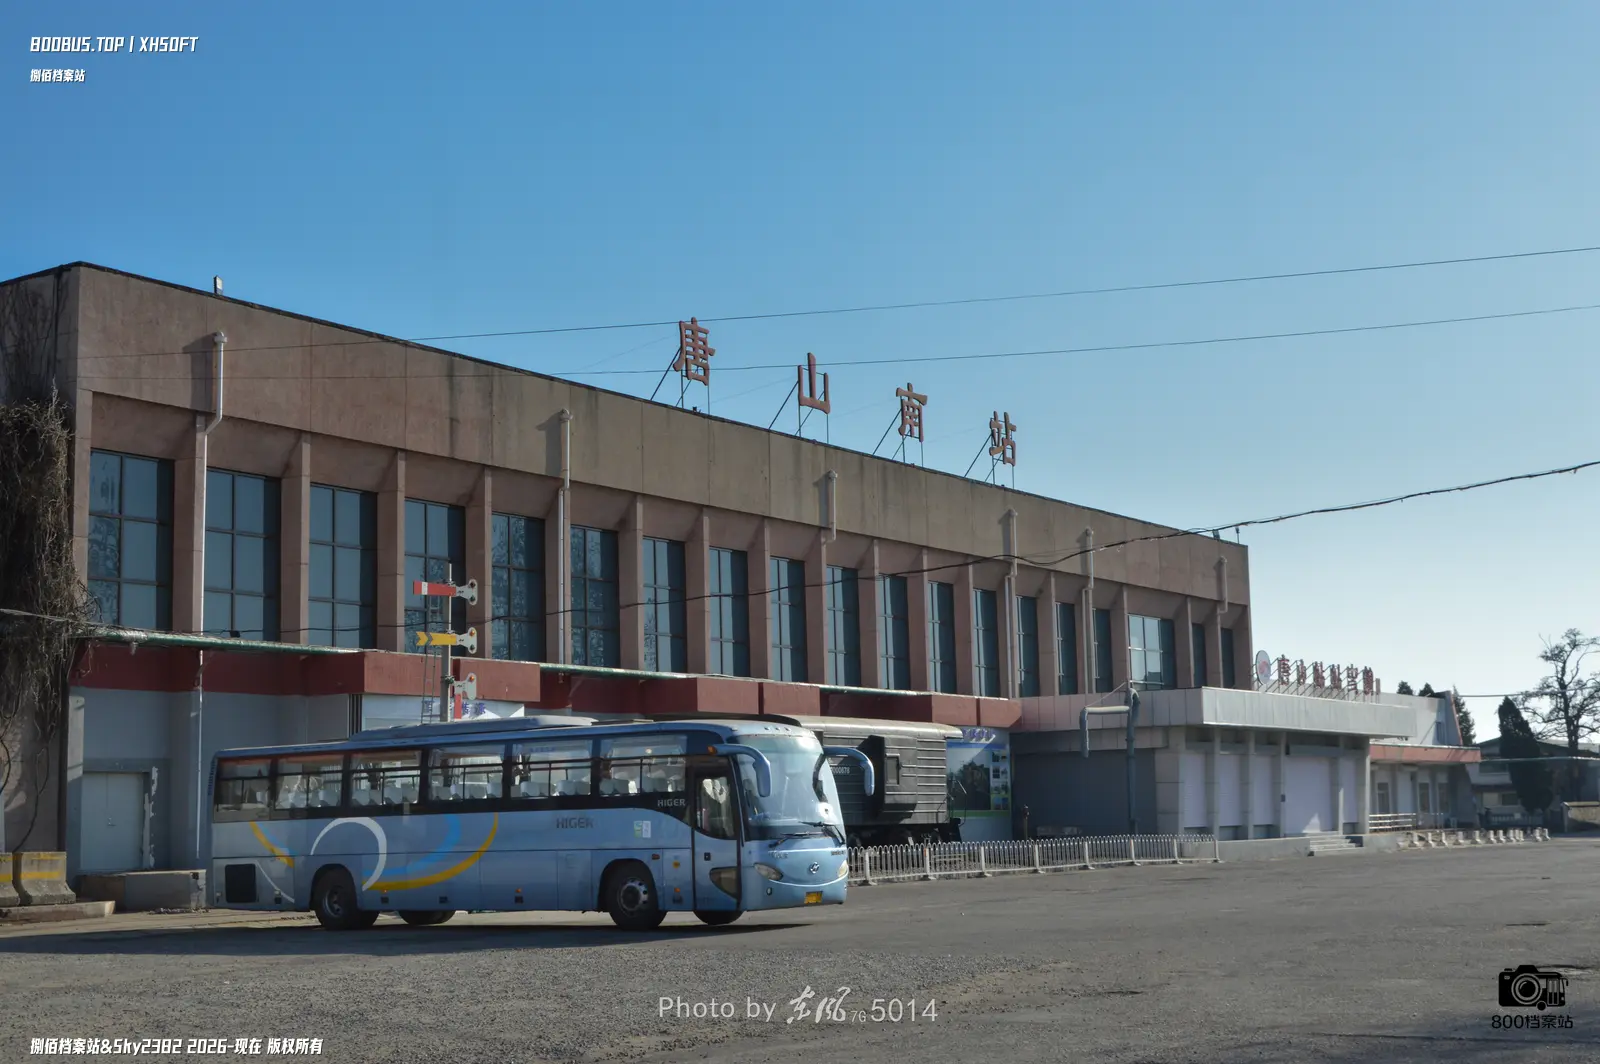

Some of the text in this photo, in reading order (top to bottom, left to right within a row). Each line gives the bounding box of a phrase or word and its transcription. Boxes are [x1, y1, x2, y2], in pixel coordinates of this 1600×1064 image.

[673, 317, 1017, 466] 唐山南站
[657, 798, 686, 809] HIGER
